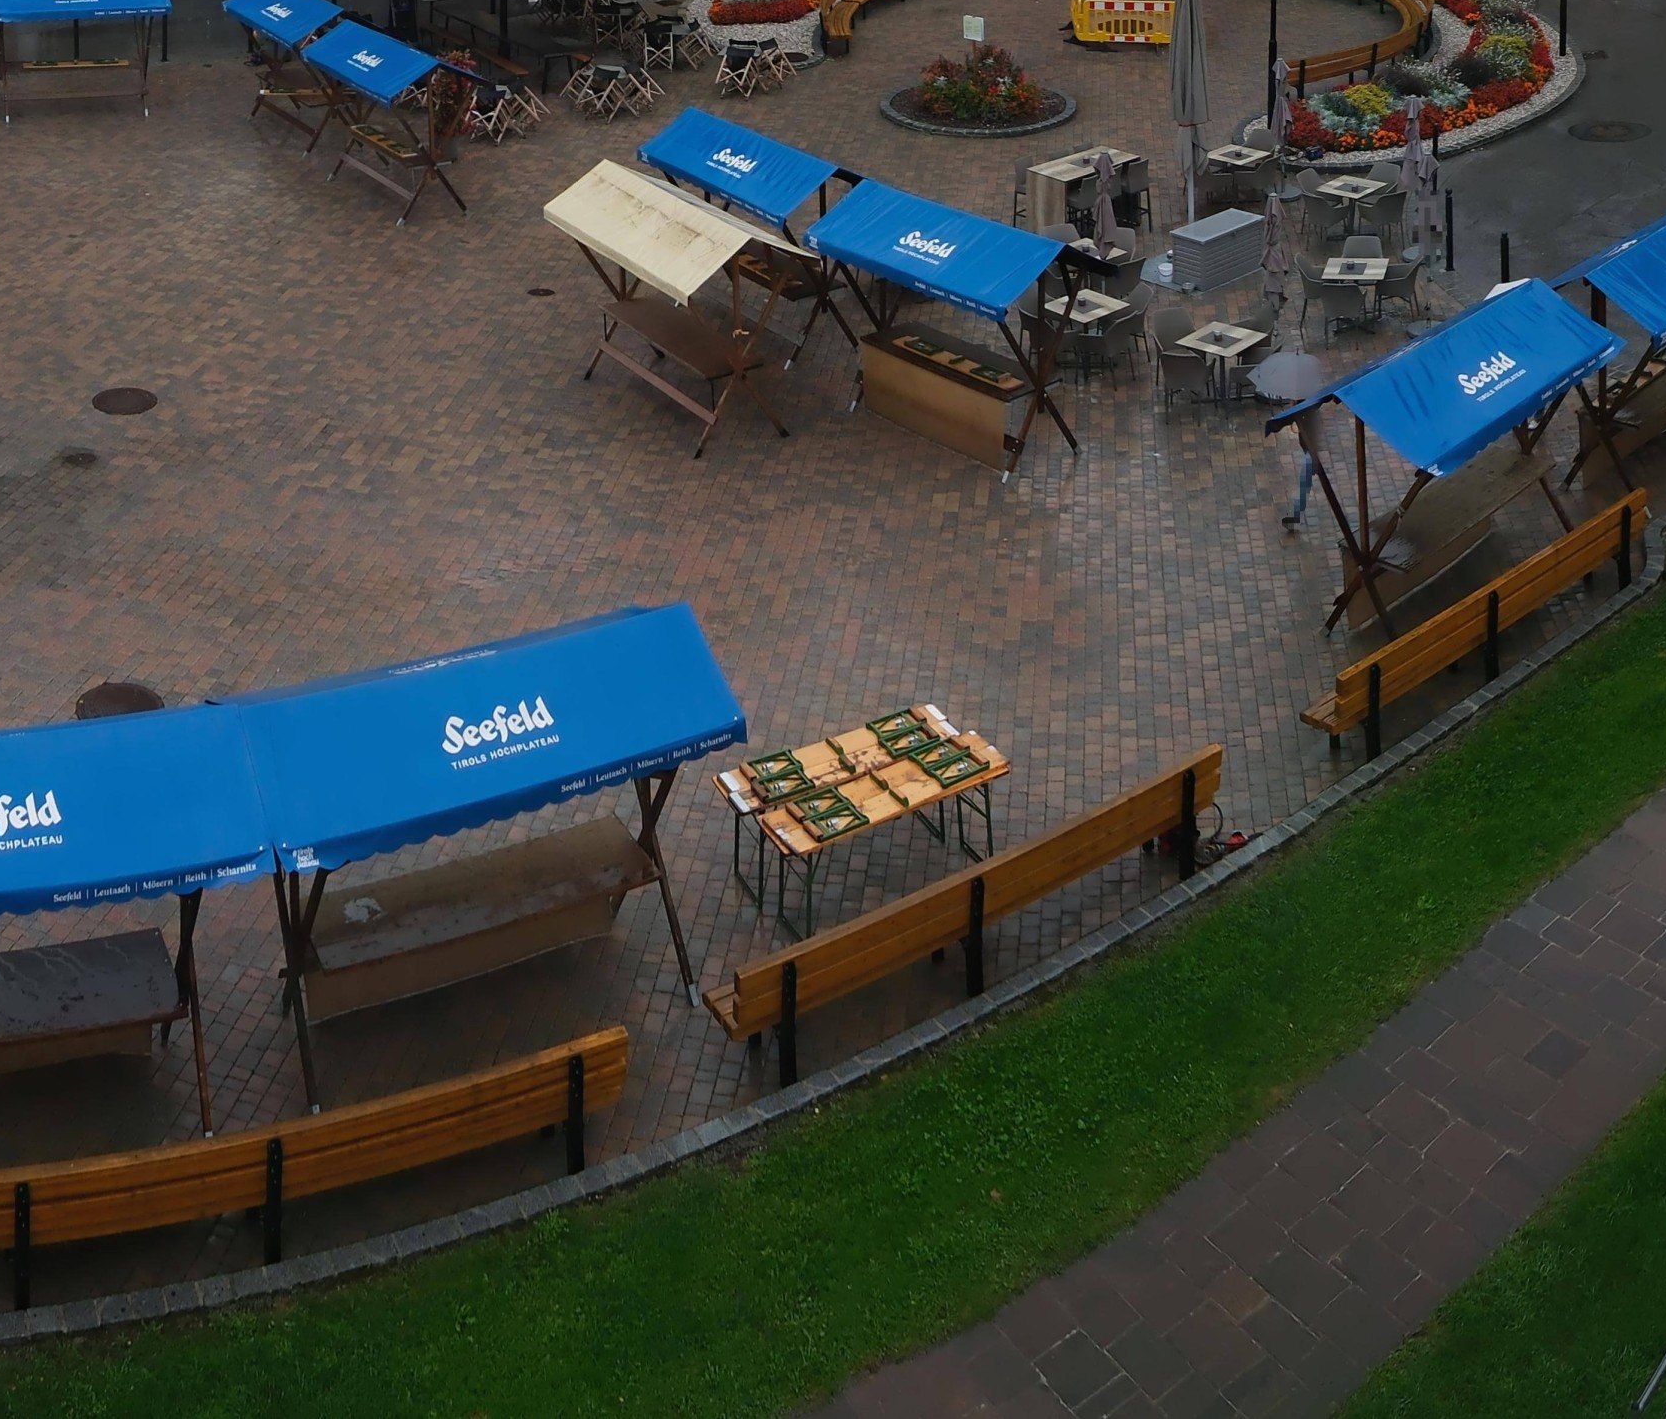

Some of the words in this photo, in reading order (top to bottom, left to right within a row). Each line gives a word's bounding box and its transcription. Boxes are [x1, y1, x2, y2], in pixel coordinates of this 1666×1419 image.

[713, 148, 757, 173] Seefeld
[900, 230, 957, 259] Seefeld
[1458, 351, 1516, 395] Seefeld
[442, 695, 555, 755] Seefeld
[450, 753, 488, 770] TIROLS
[490, 734, 560, 761] HOCHPLATEAU
[561, 778, 586, 793] Seefeld
[595, 764, 627, 783] Leutasch
[637, 754, 664, 770] Mösern
[673, 745, 692, 760] Reith
[700, 731, 732, 751] Scharnitz
[53, 889, 82, 903] Seefeld
[94, 884, 131, 898] Leutasch
[143, 876, 174, 891] Mösern
[185, 870, 208, 883] Reith
[217, 862, 257, 878] Scharnitz
